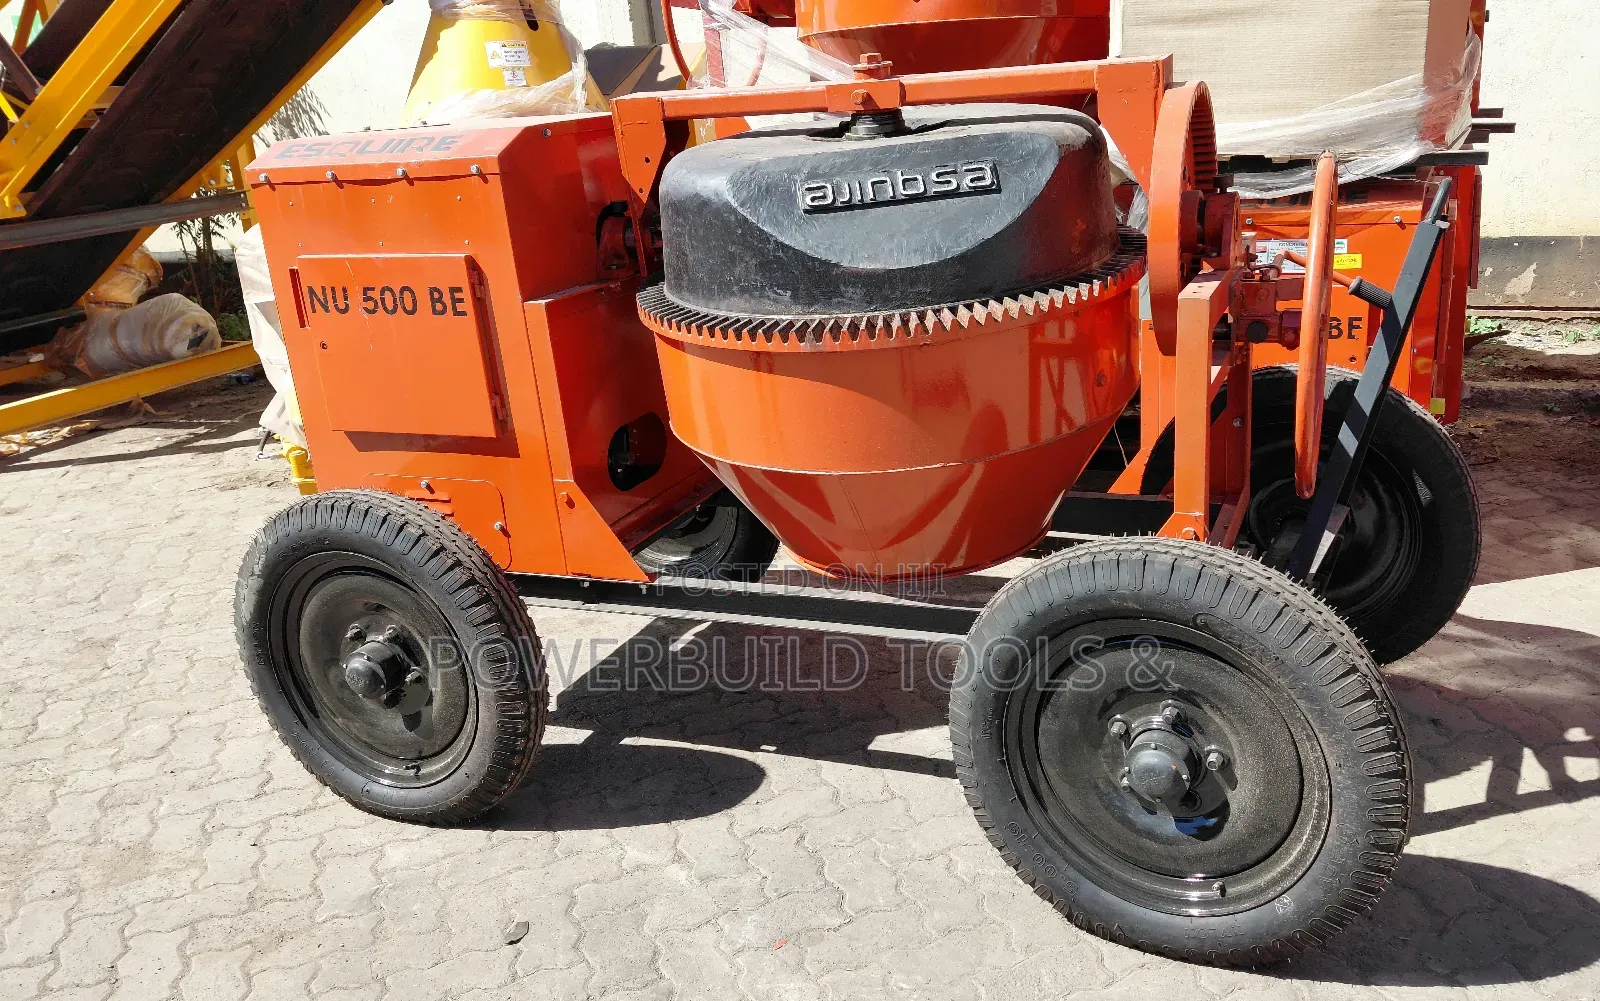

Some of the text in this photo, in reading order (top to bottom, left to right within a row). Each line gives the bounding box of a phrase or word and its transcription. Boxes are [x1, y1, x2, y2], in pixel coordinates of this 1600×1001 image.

[274, 134, 463, 160] ESQUIRE
[307, 285, 467, 316] NU 500 BE
